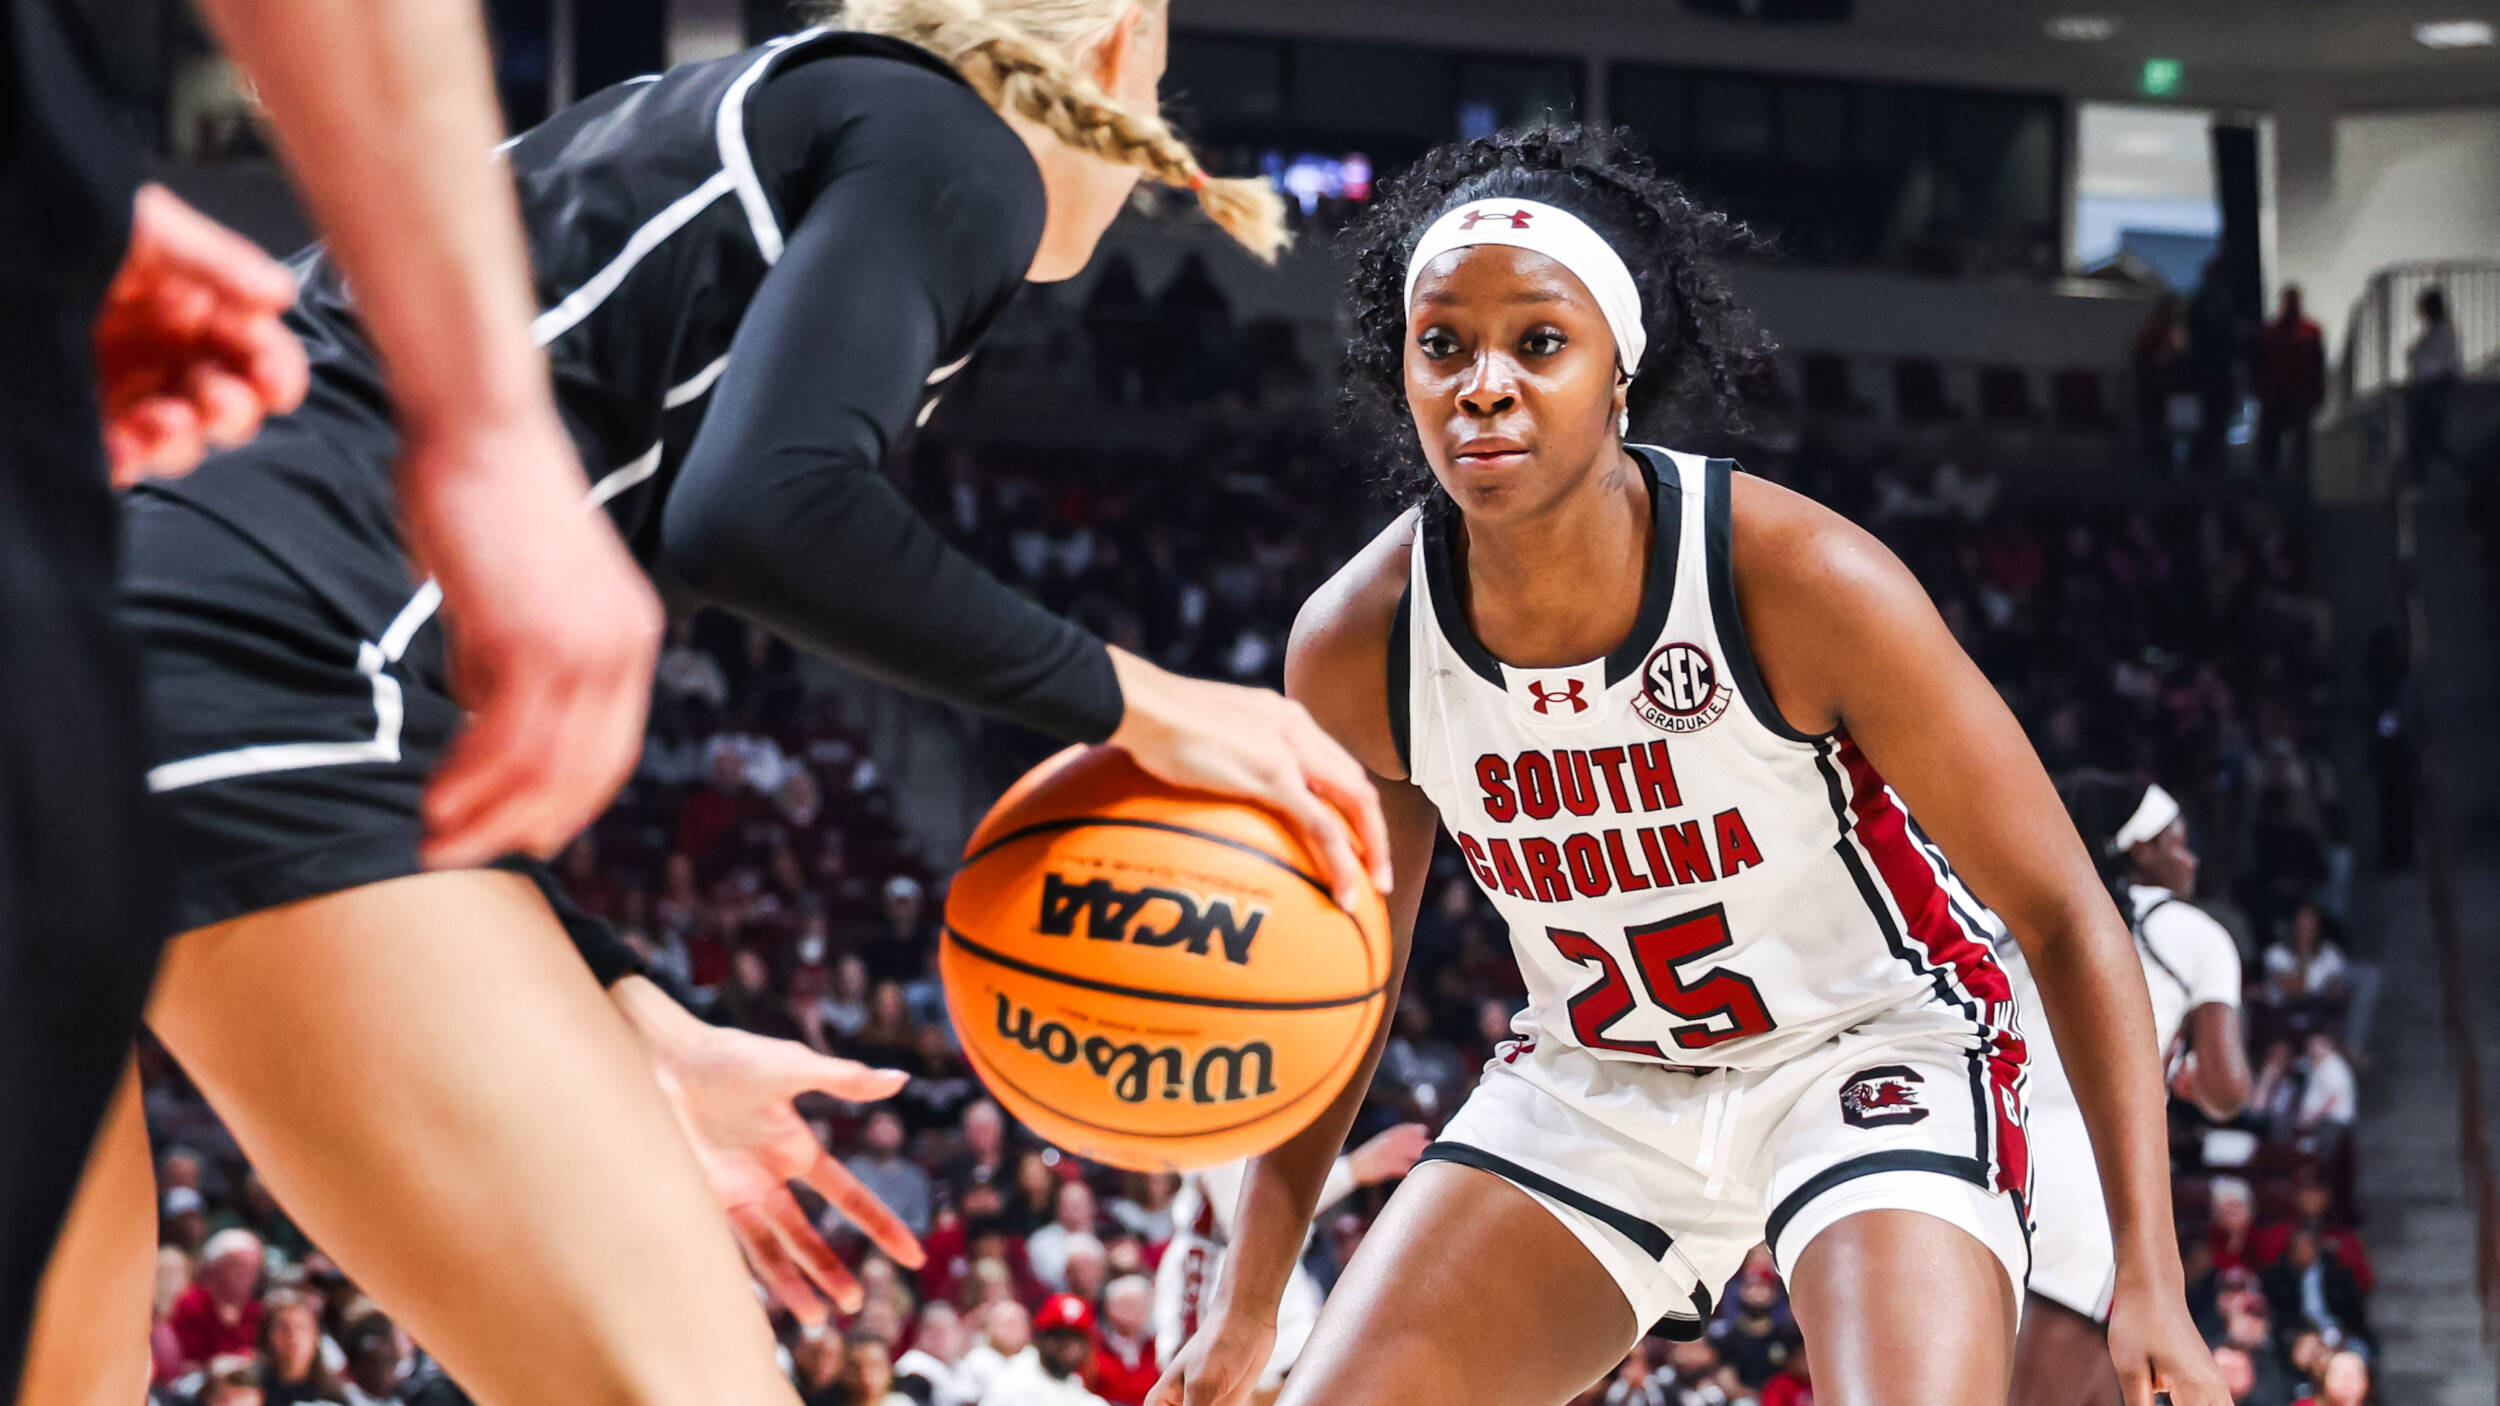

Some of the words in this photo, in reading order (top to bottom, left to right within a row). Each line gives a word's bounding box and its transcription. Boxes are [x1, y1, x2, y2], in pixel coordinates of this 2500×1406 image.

[1645, 702, 1723, 731] GRADUATE
[1647, 646, 1710, 711] SEC
[1475, 738, 1683, 823] SOUTH
[1458, 807, 1764, 902] CAROLINA
[1037, 872, 1264, 965] NCAA
[1545, 902, 1778, 1063] 25
[995, 991, 1278, 1104] Wilson
